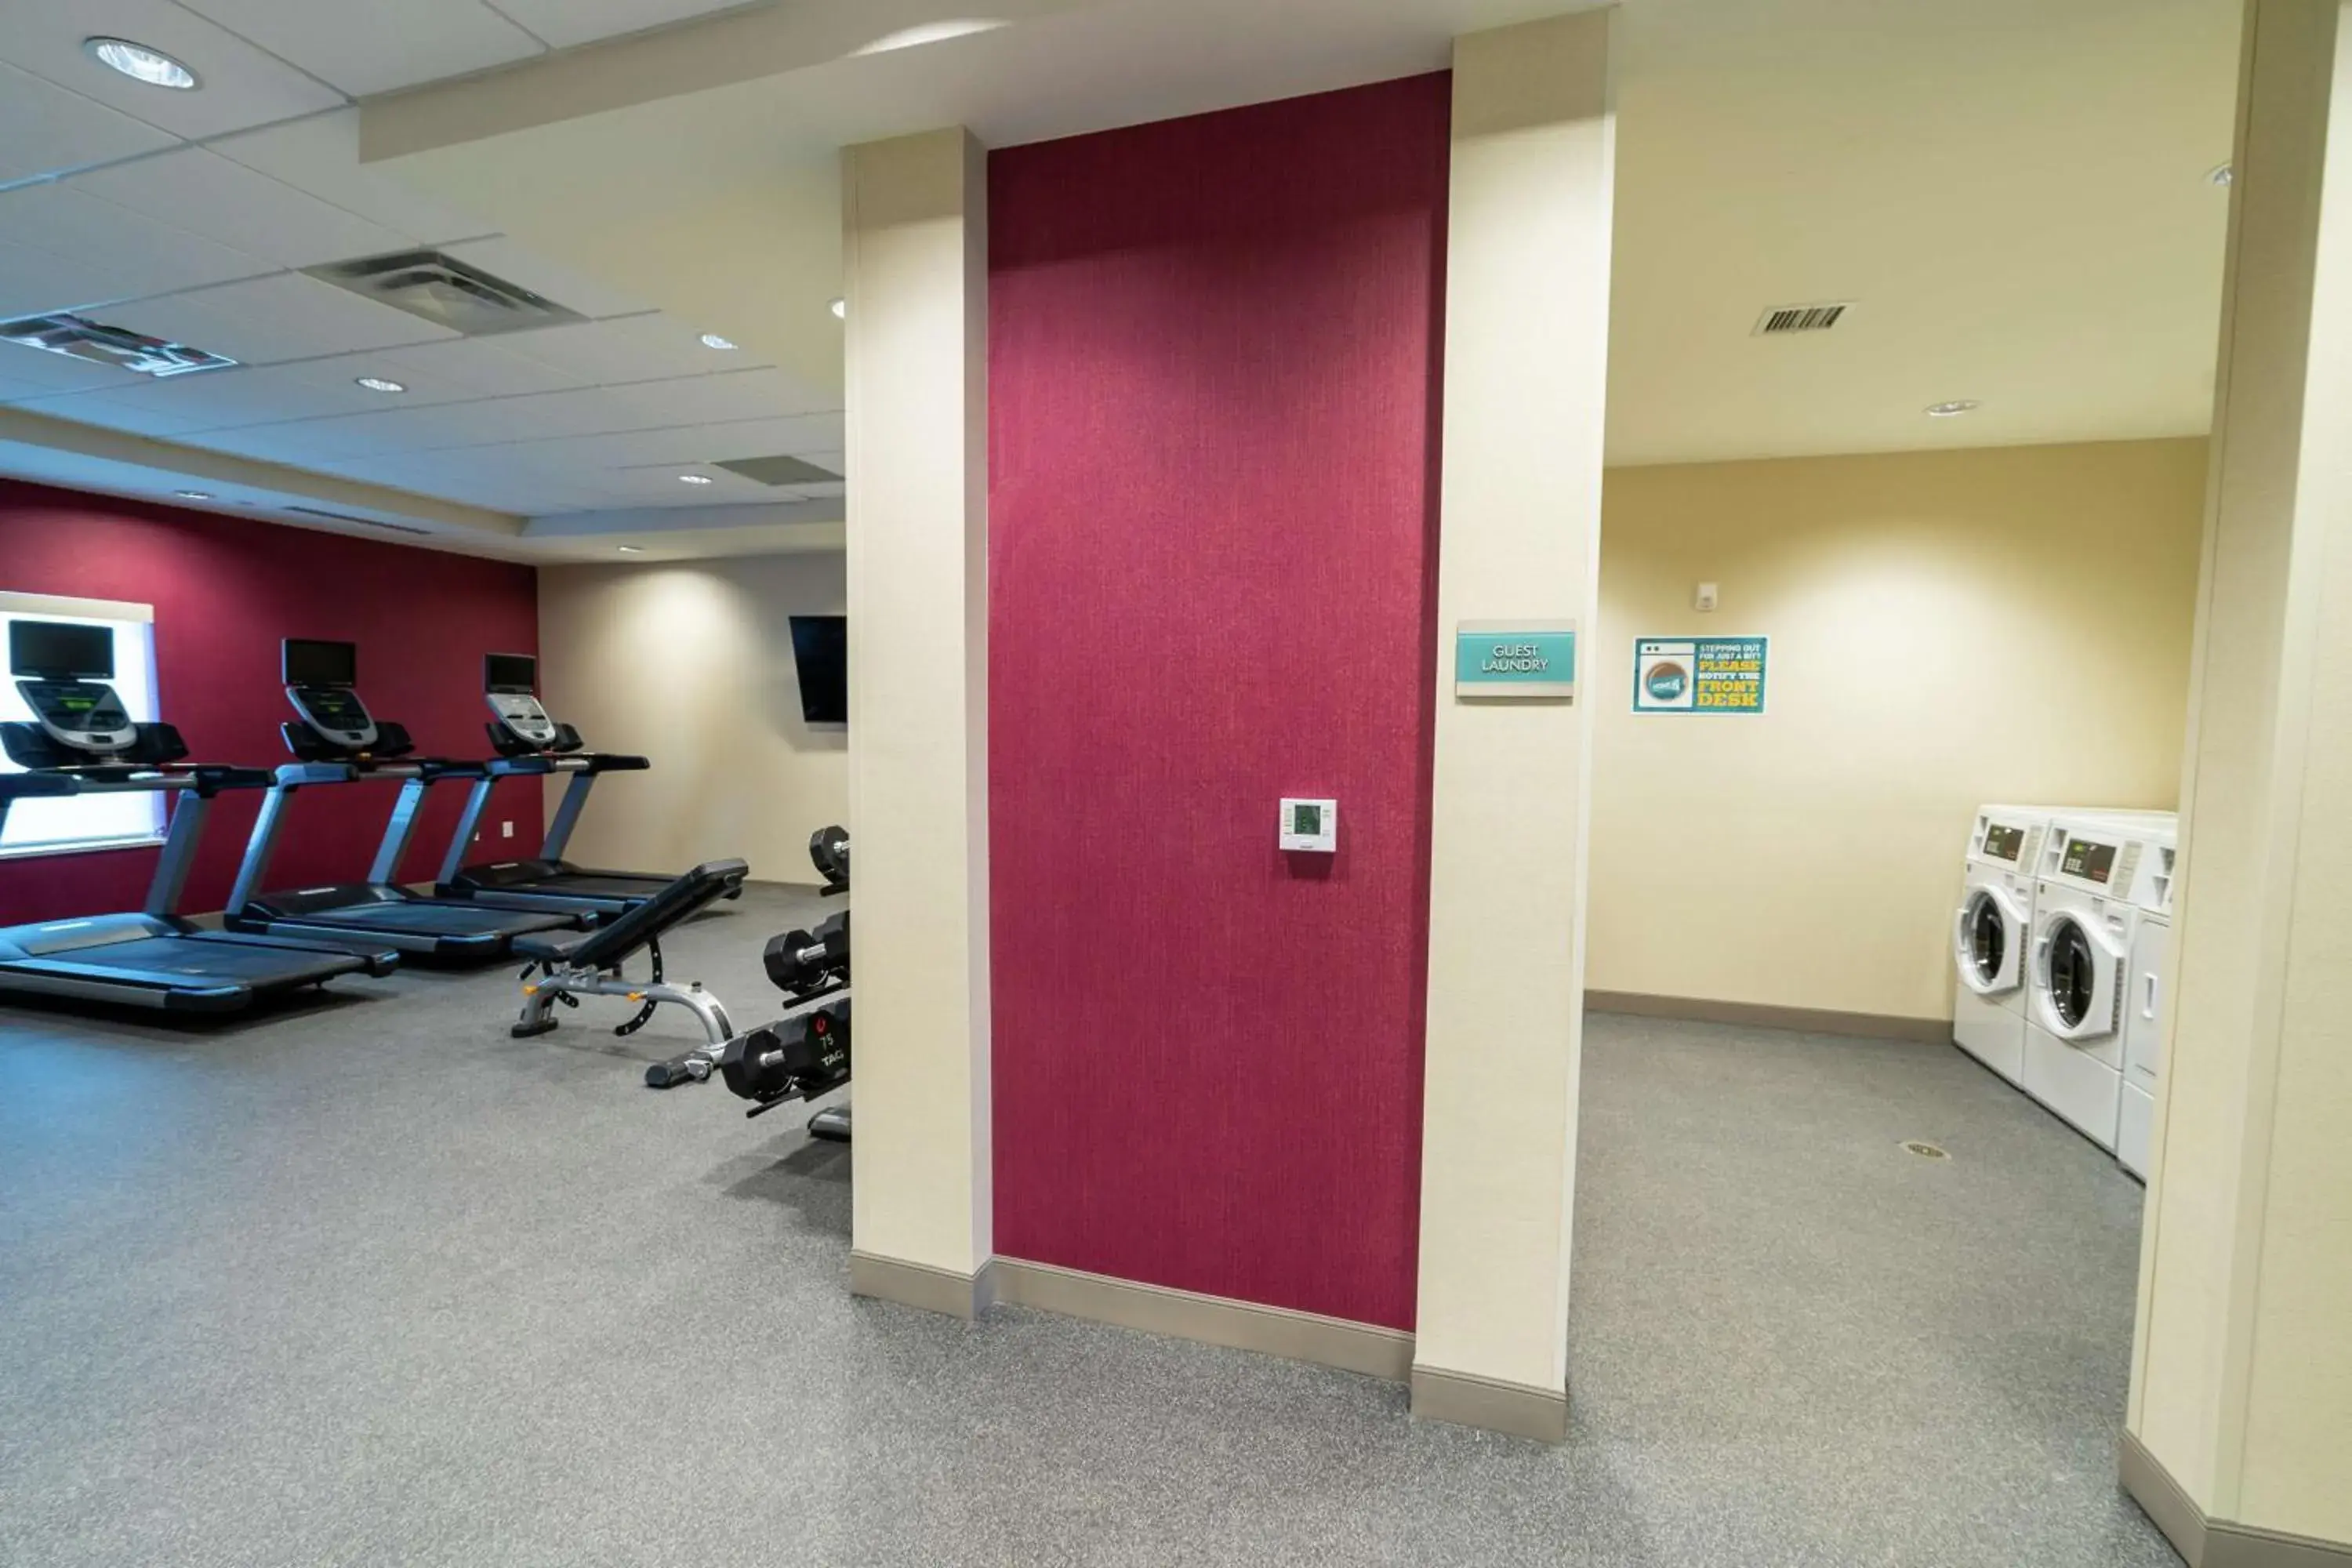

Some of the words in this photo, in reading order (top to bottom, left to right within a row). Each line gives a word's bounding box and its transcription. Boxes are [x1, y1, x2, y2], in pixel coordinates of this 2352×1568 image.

[1493, 644, 1538, 657] GUEST
[1743, 643, 1760, 652] OUT
[1482, 658, 1548, 672] LAUNDRY
[1699, 661, 1760, 671] PLEASE
[1698, 681, 1759, 692] FRONT
[1697, 693, 1758, 706] DESK
[819, 1032, 835, 1051] 75
